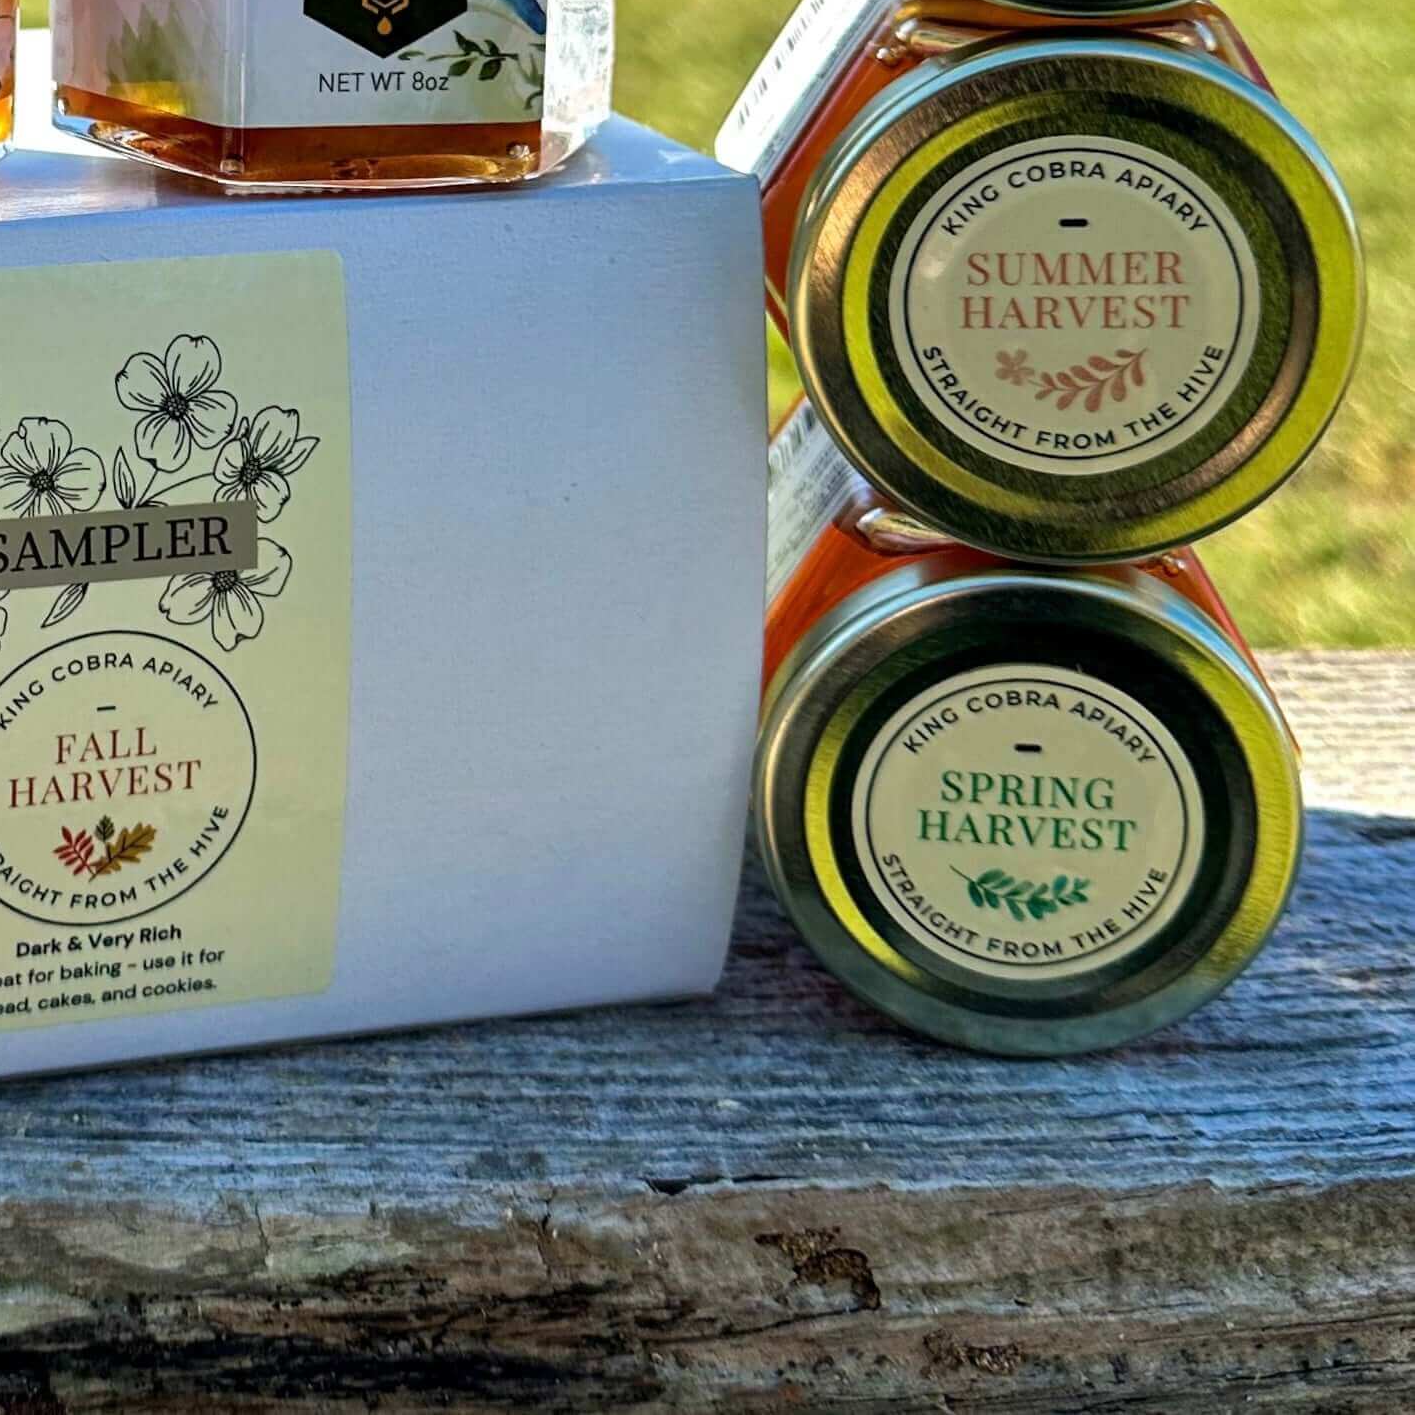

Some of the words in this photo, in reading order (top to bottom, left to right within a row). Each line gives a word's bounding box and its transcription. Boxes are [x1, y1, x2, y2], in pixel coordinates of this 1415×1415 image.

[318, 73, 364, 92] NET
[370, 72, 405, 91] WT
[412, 71, 450, 90] 8oz
[941, 184, 1000, 236] KING
[1007, 161, 1106, 189] COBRA
[1115, 169, 1210, 234] APIARY
[966, 251, 1185, 287] SUMMER
[960, 294, 1190, 330] HARVEST
[922, 346, 1029, 440] STRAIGHT
[1036, 430, 1116, 449] FROM
[1125, 403, 1177, 437] THE
[1177, 346, 1225, 402] HIVE
[51, 653, 134, 683] COBRA
[142, 657, 219, 710] APIARY
[55, 727, 157, 765] FALL
[902, 707, 960, 755] KING
[966, 689, 1060, 714] COBRA
[1069, 700, 1157, 766] APIARY
[8, 760, 202, 809] HARVEST
[940, 769, 1115, 812] SPRING
[918, 809, 1137, 852] HARVEST
[70, 890, 138, 909] FROM
[145, 861, 189, 892] THE
[191, 805, 229, 858] HIVE
[882, 854, 980, 945] STRAIGHT
[986, 938, 1063, 958] FROM
[1071, 918, 1122, 950] THE
[1121, 867, 1169, 920] HIVE
[16, 939, 62, 958] Dark
[67, 936, 82, 952] &
[88, 931, 134, 950] Very
[139, 925, 182, 943] Rich
[28, 968, 54, 986] for
[60, 961, 121, 981] baking
[143, 955, 176, 971] use
[181, 950, 193, 966] it
[199, 949, 225, 965] for
[38, 991, 96, 1010] cakes,
[102, 985, 137, 1002] and
[142, 978, 218, 998] cookies.
